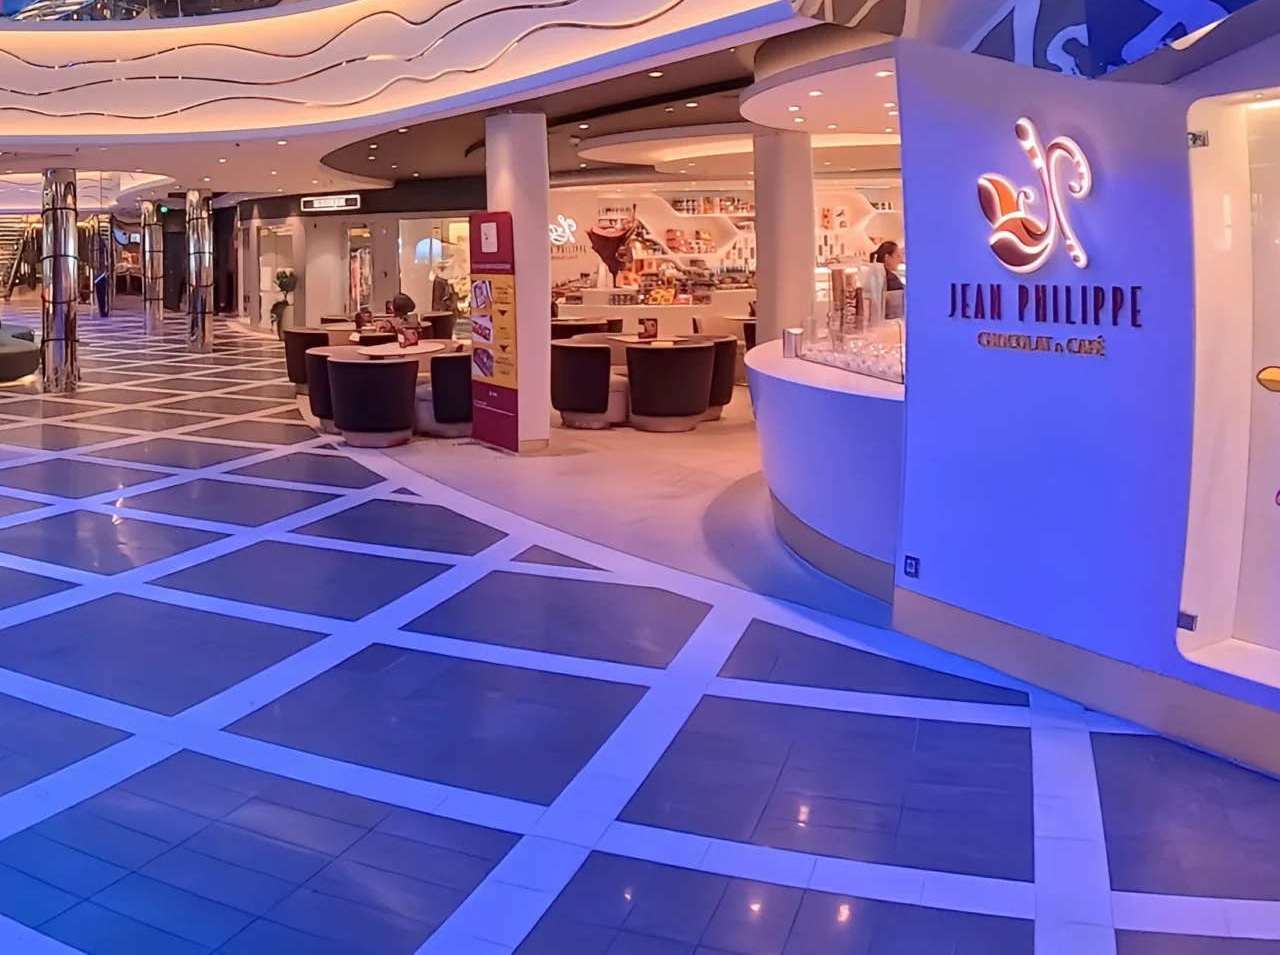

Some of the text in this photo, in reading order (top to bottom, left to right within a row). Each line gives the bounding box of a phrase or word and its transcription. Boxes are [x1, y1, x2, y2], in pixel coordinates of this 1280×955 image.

[948, 283, 1143, 328] JEAN PHILIPPE
[977, 331, 1054, 352] CCLT
